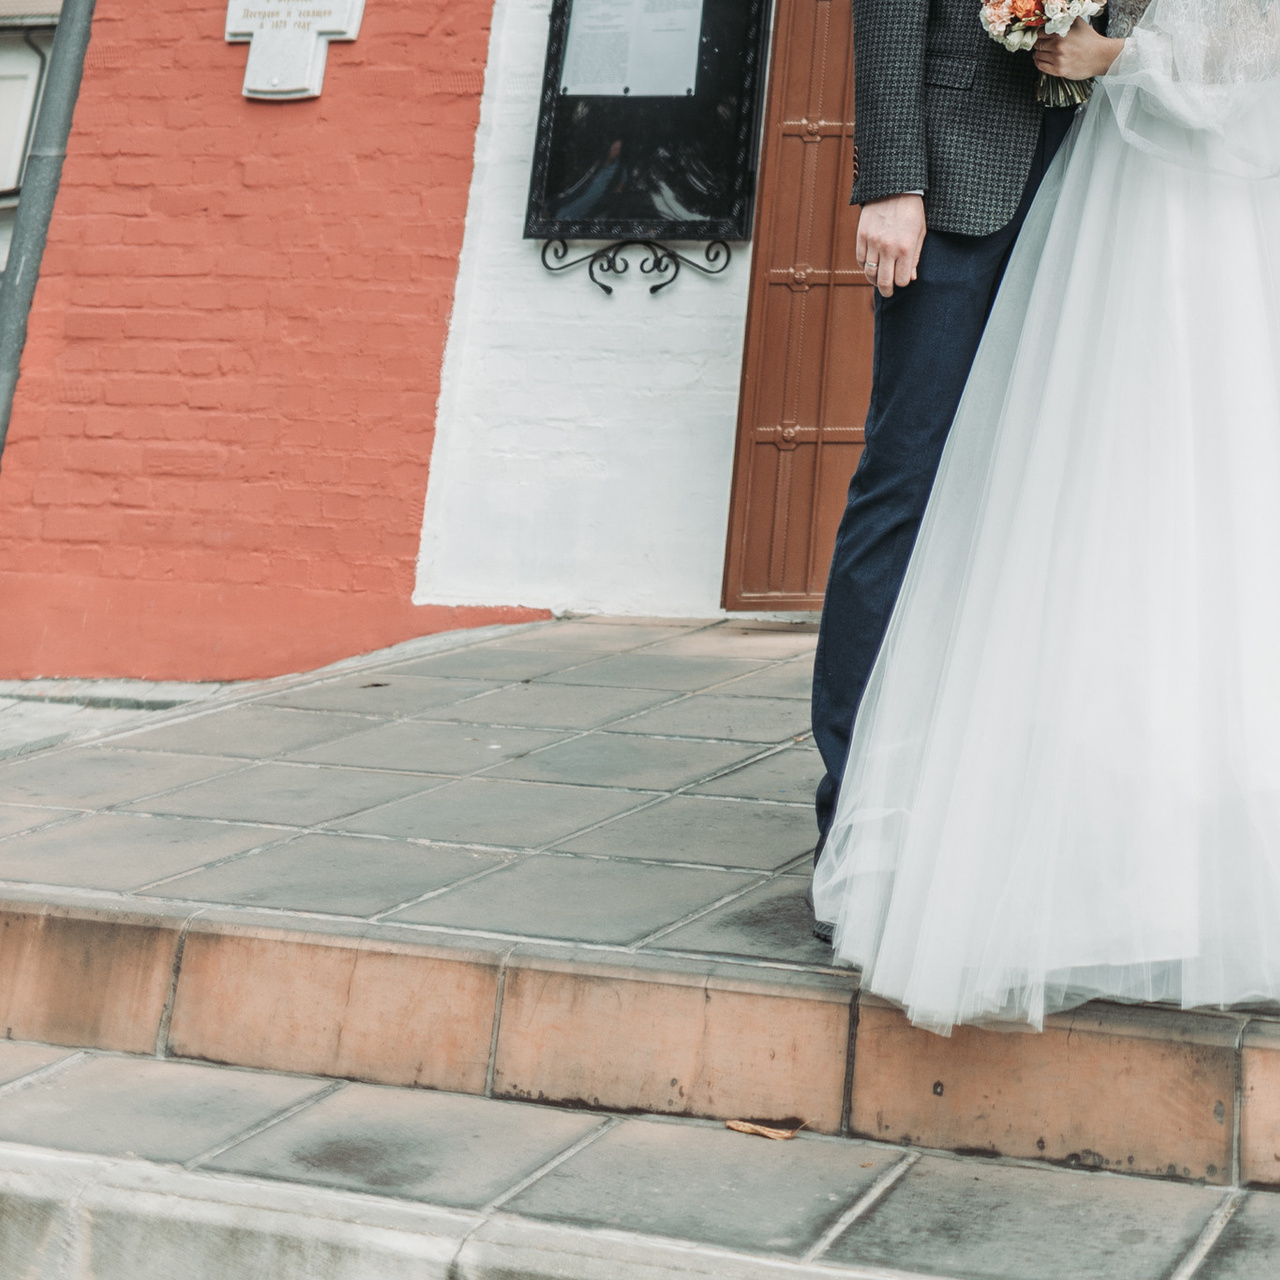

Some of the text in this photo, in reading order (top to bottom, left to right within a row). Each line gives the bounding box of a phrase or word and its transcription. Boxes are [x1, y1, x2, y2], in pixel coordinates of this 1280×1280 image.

[242, 8, 280, 19] Построен
[286, 9, 292, 17] и
[293, 20, 312, 31] году
